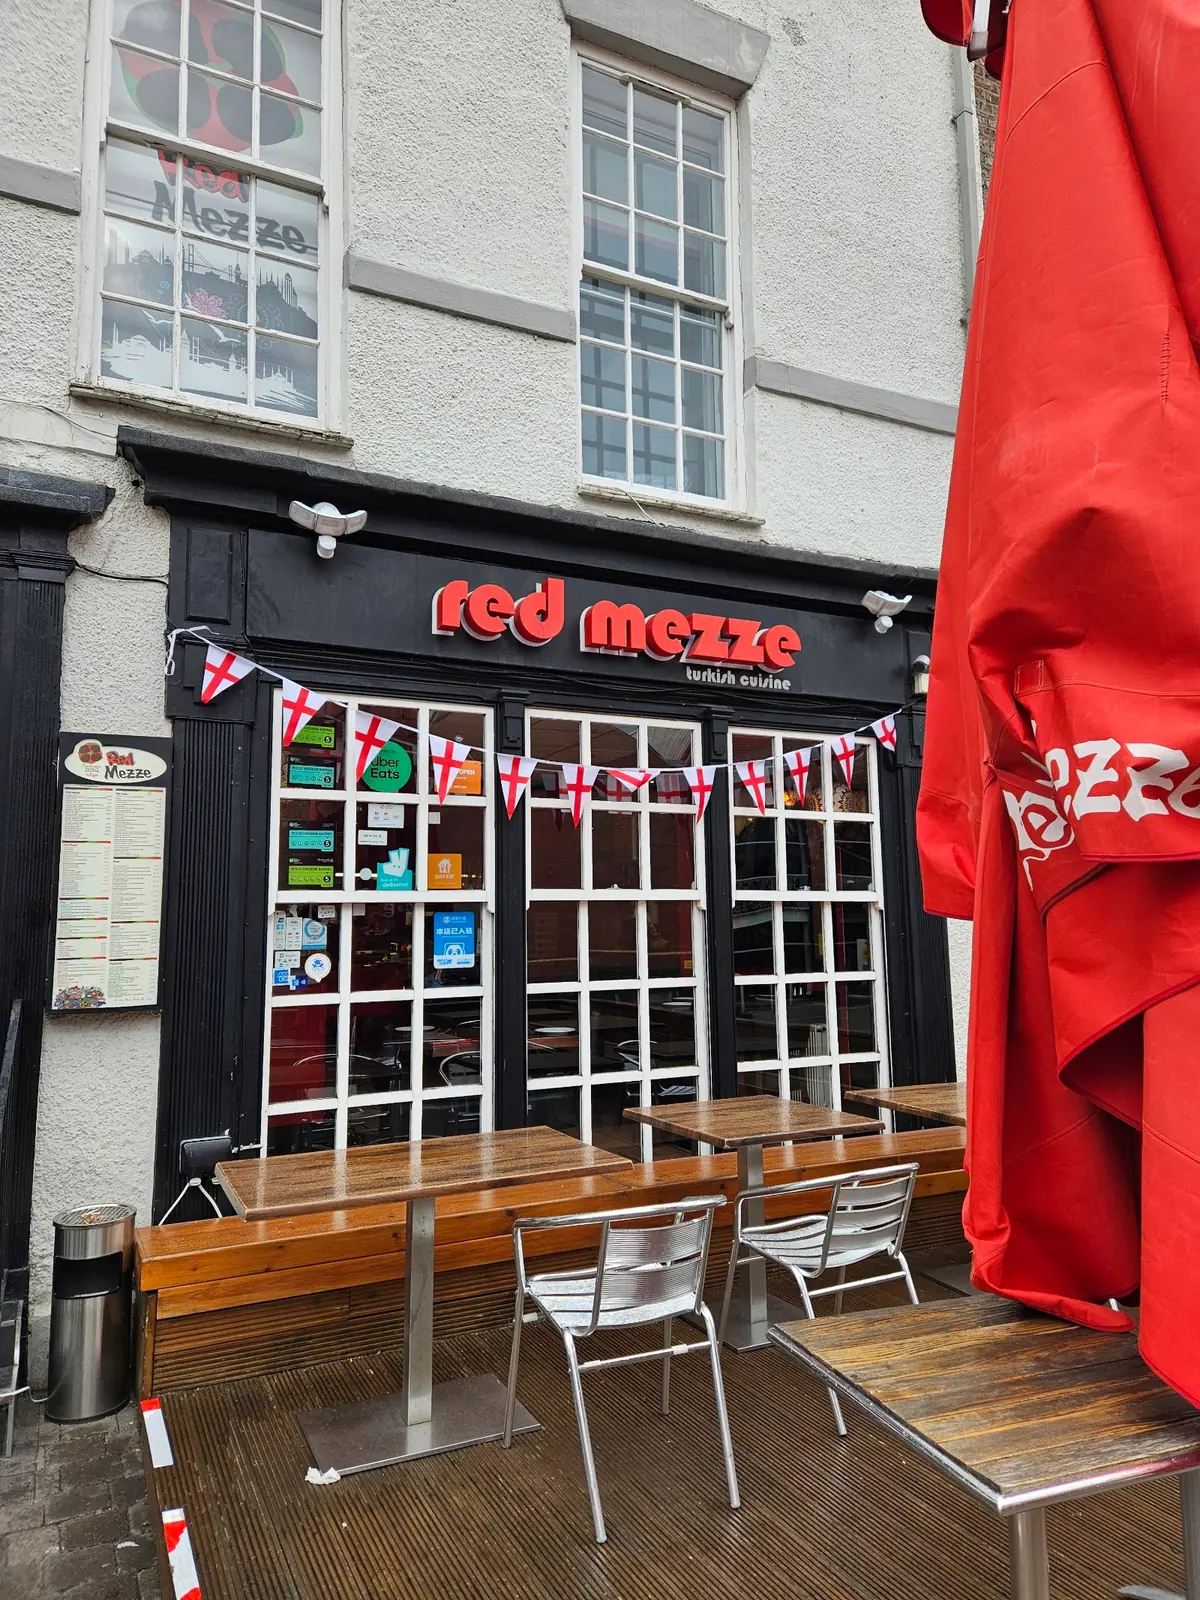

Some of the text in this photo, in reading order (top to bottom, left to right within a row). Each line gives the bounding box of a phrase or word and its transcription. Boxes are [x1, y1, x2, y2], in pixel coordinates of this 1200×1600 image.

[151, 180, 308, 253] Mezze
[432, 577, 802, 673] red mezze
[685, 665, 792, 691] turkish cuisine
[106, 751, 135, 766] Red
[371, 756, 400, 768] Uber
[104, 765, 152, 780] Mezze
[371, 768, 400, 779] Eats
